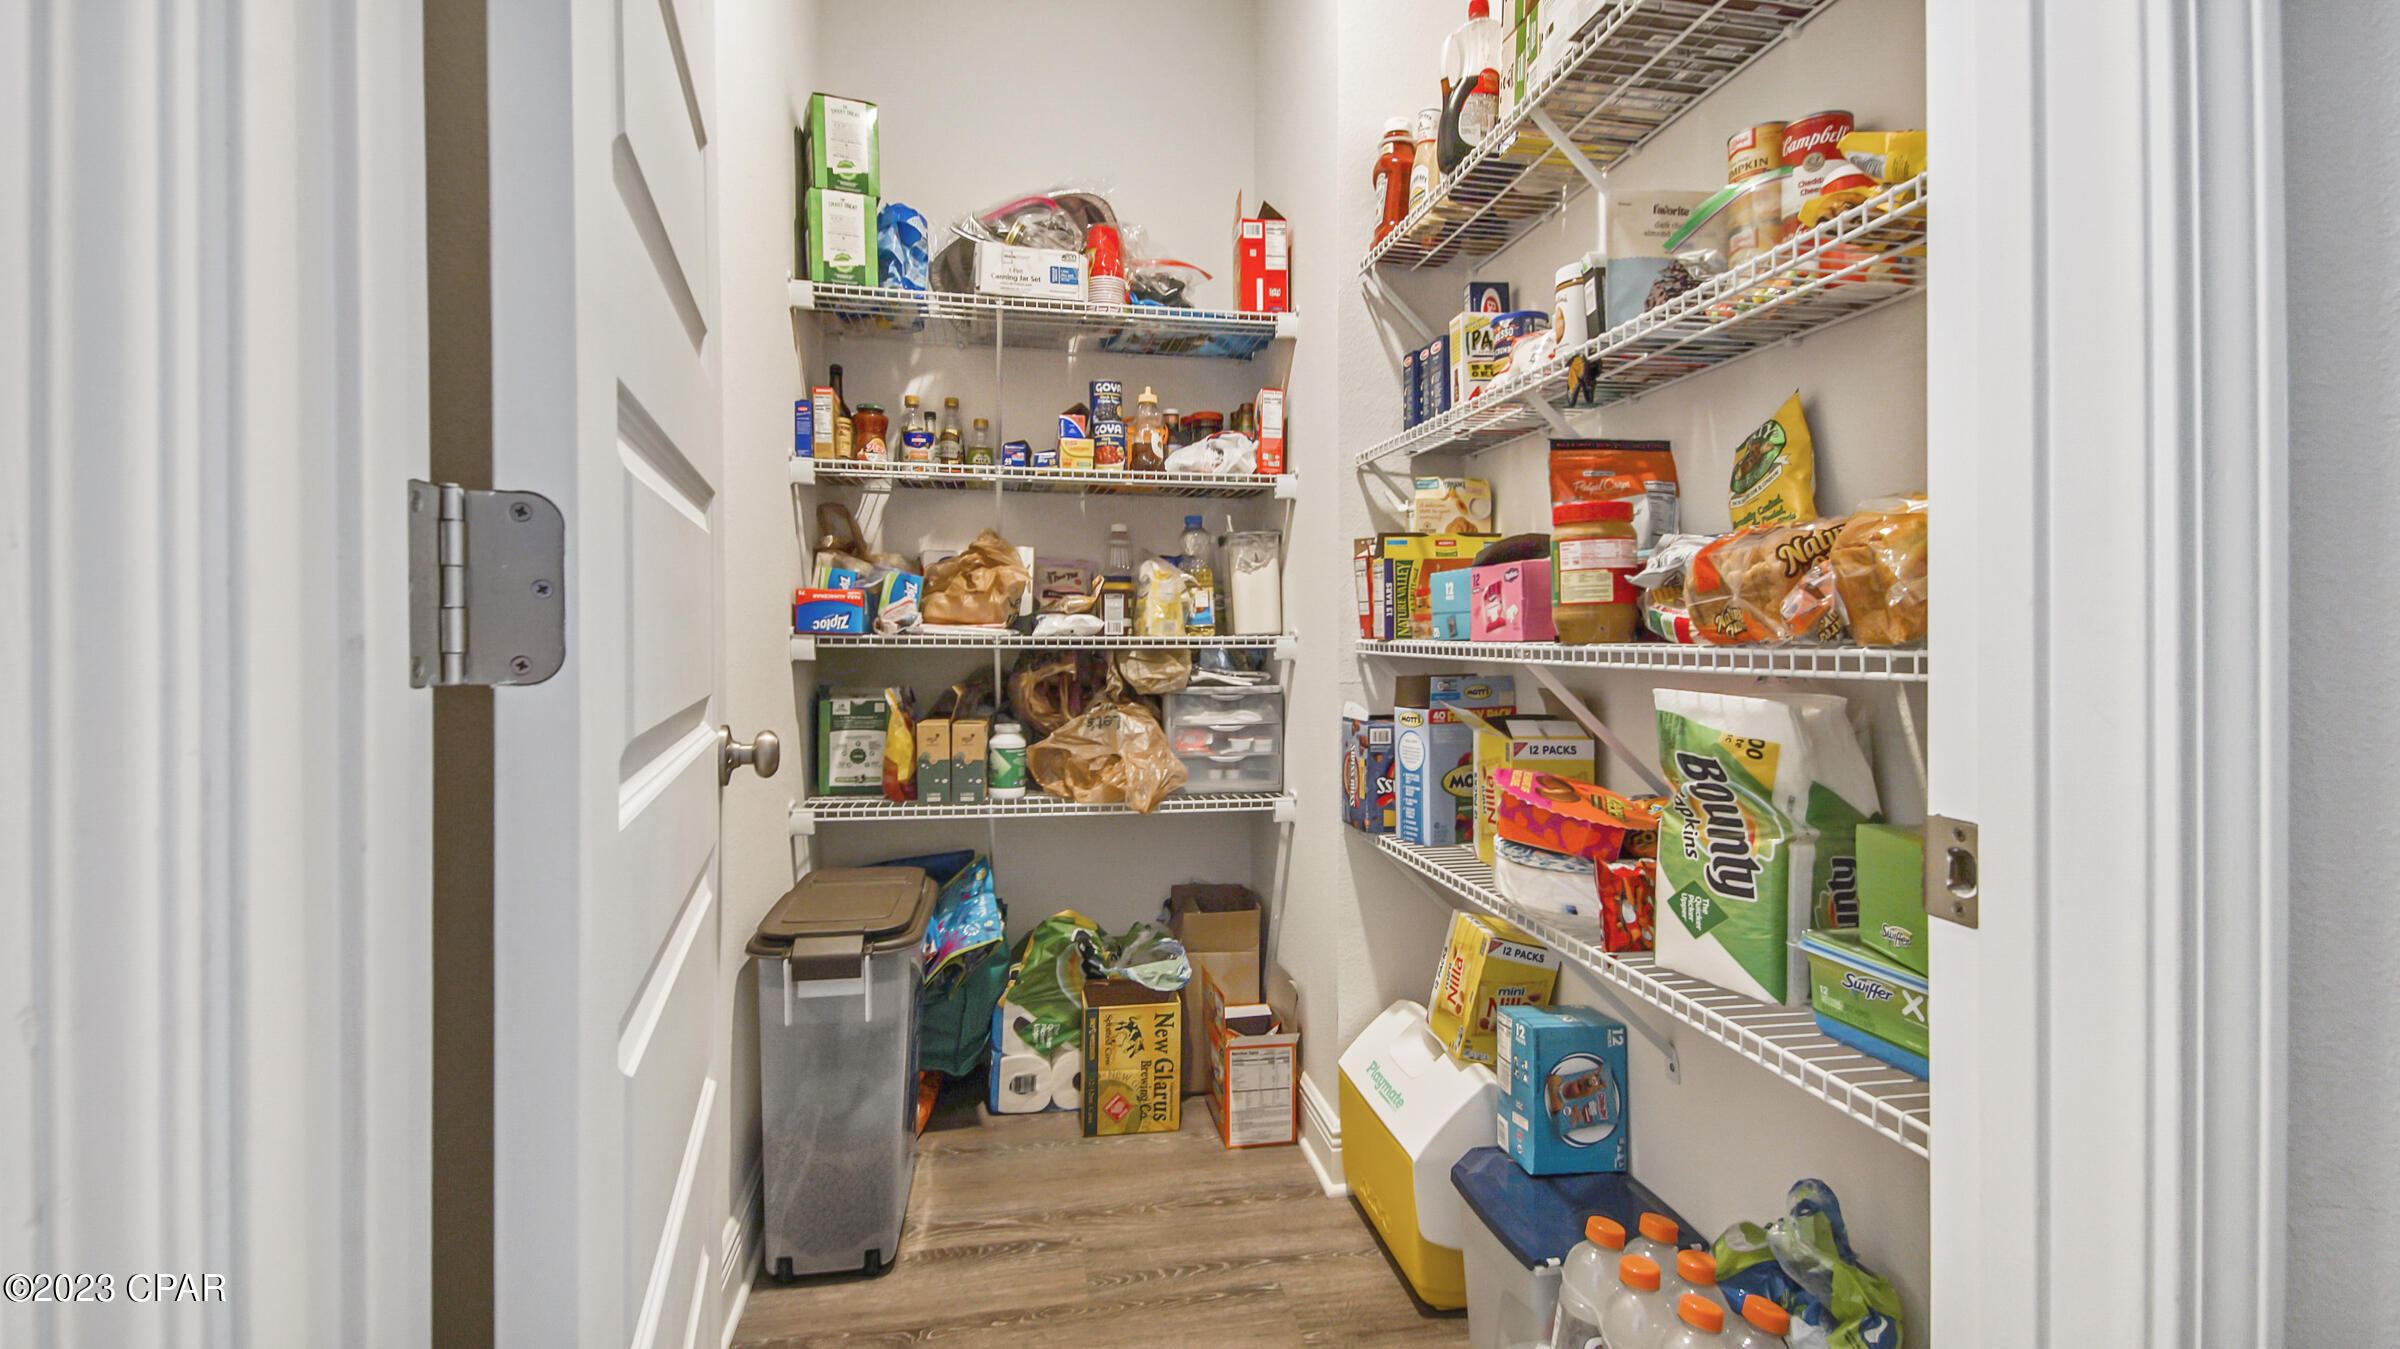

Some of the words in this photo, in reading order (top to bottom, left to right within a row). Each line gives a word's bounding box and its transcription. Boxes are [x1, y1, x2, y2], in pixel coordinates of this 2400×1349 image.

[1095, 382, 1122, 393] GOYA
[1094, 424, 1122, 435] GOYA
[1445, 582, 1454, 595] 12
[1473, 573, 1480, 587] 12
[812, 613, 851, 631] Ziploc
[1432, 711, 1446, 720] 40
[1529, 745, 1539, 755] 12
[1542, 745, 1578, 756] PACKS
[1485, 775, 1497, 825] Nilla
[1676, 753, 1762, 901] Bounty
[1680, 892, 1689, 921] Upper
[1687, 894, 1696, 923] Picker
[1694, 896, 1703, 931] Quicker
[1702, 897, 1710, 915] The
[1882, 923, 1911, 947] Swiffer
[1503, 946, 1512, 956] 12
[1514, 948, 1545, 963] PACKS
[1447, 956, 1464, 1006] Nilla
[1497, 986, 1526, 996] mini
[1842, 972, 1893, 1001] Swiffer
[1154, 1012, 1175, 1054] New
[1515, 1022, 1526, 1039] 12
[1612, 1028, 1624, 1046] 12
[1137, 1060, 1152, 1102] Brewing
[1152, 1058, 1175, 1122] Glarus
[1365, 1060, 1404, 1109] Playmate
